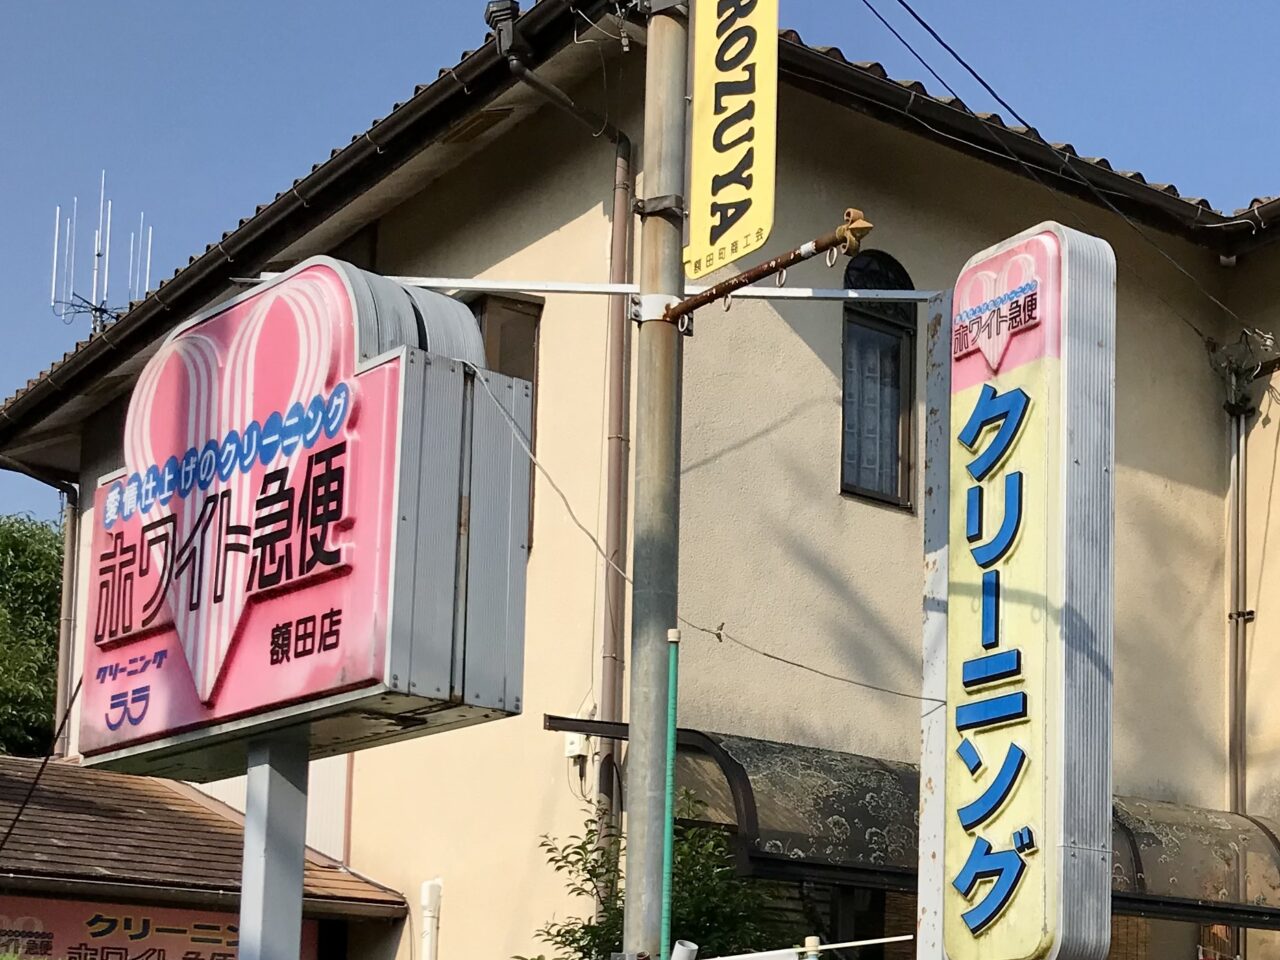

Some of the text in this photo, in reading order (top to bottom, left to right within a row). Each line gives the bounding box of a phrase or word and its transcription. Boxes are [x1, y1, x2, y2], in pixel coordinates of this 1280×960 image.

[953, 292, 1038, 355] ホワイト急便
[104, 389, 347, 524] 愛情仕上げのクリーニング
[94, 441, 348, 644] ホワイト急便
[95, 648, 169, 685] クリーニング
[269, 607, 343, 666] 額田店
[952, 383, 1035, 938] クリーニング
